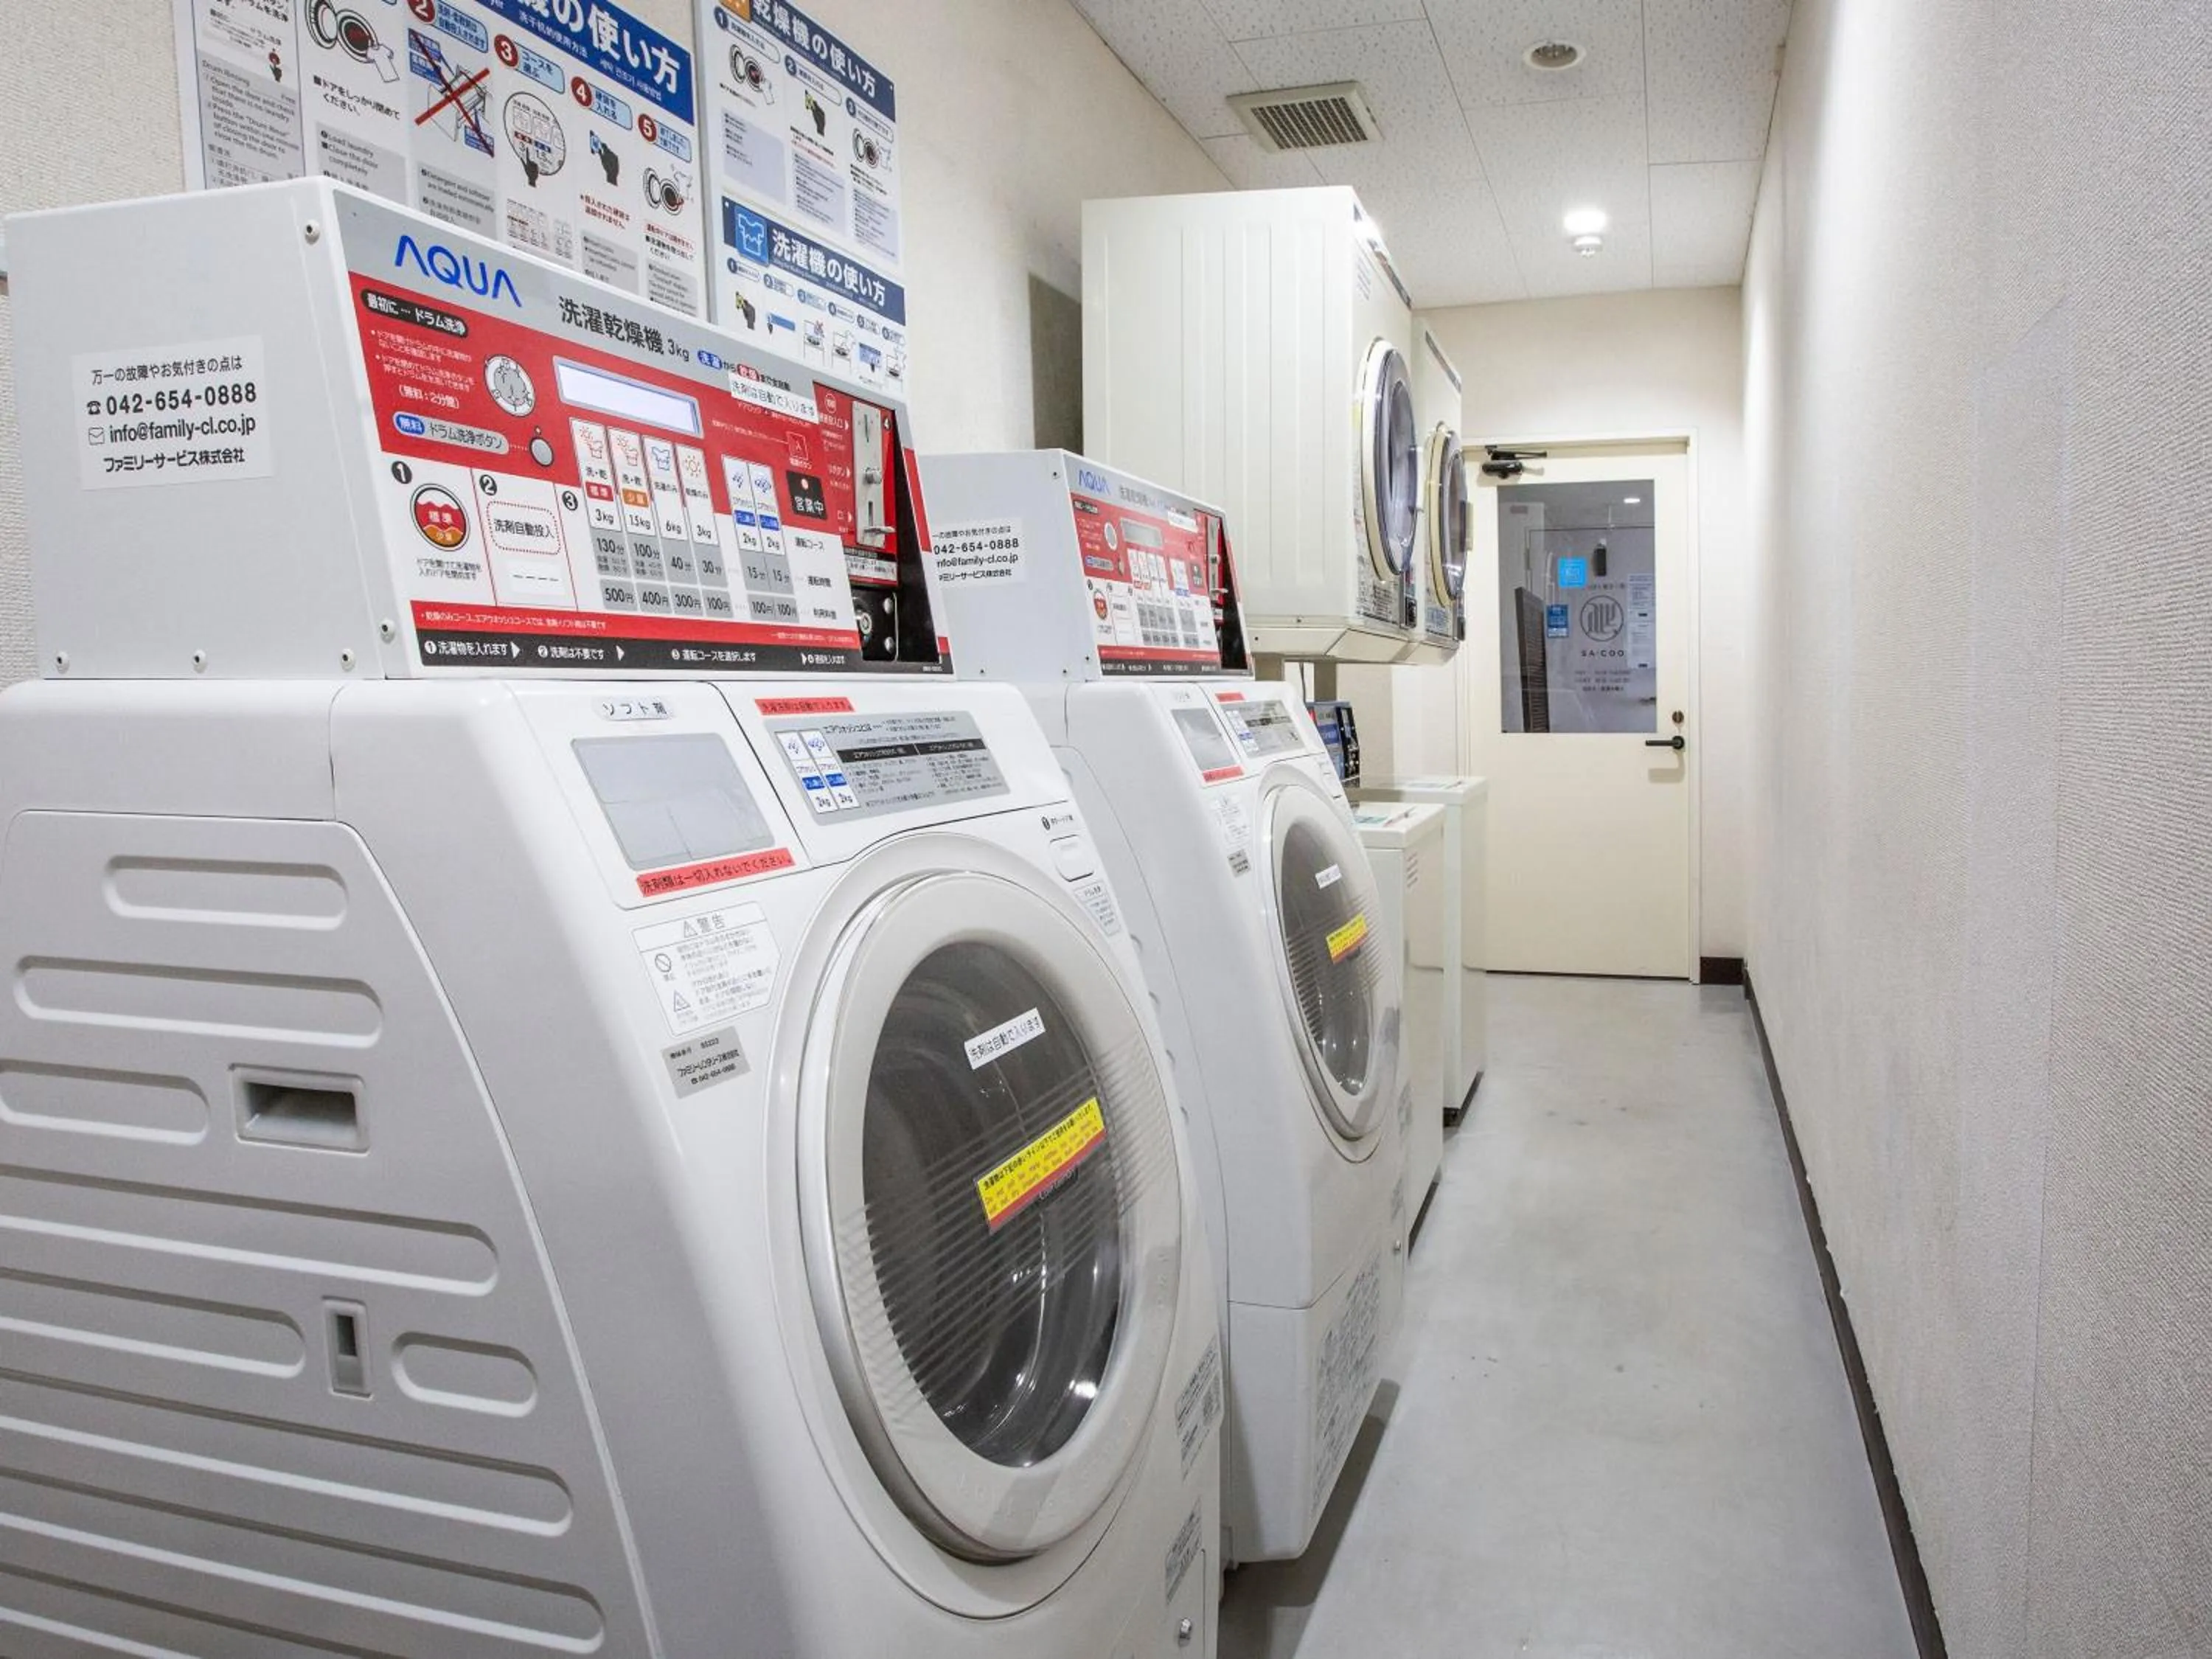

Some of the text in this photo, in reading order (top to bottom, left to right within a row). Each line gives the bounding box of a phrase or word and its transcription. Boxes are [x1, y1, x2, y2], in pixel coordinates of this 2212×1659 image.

[394, 235, 522, 307] AQUA
[772, 229, 885, 307] 洗濯機の使い方
[559, 296, 690, 363] 洗濯乾燥機 3kg
[91, 355, 243, 385] 万一の故障やお気付きの点は
[106, 383, 257, 415] 042-654-0888
[110, 414, 256, 444] info@family-cl.co.jp
[103, 448, 246, 473] ファミリーサービス株式会社
[494, 518, 555, 540] 洗剤自動投入
[933, 538, 1020, 555] 042-654-0888
[936, 553, 1018, 568] nfo@family-cl.co.jp
[438, 640, 507, 656] 洗濯物を入れます
[549, 647, 605, 661] 洗剤は不要です
